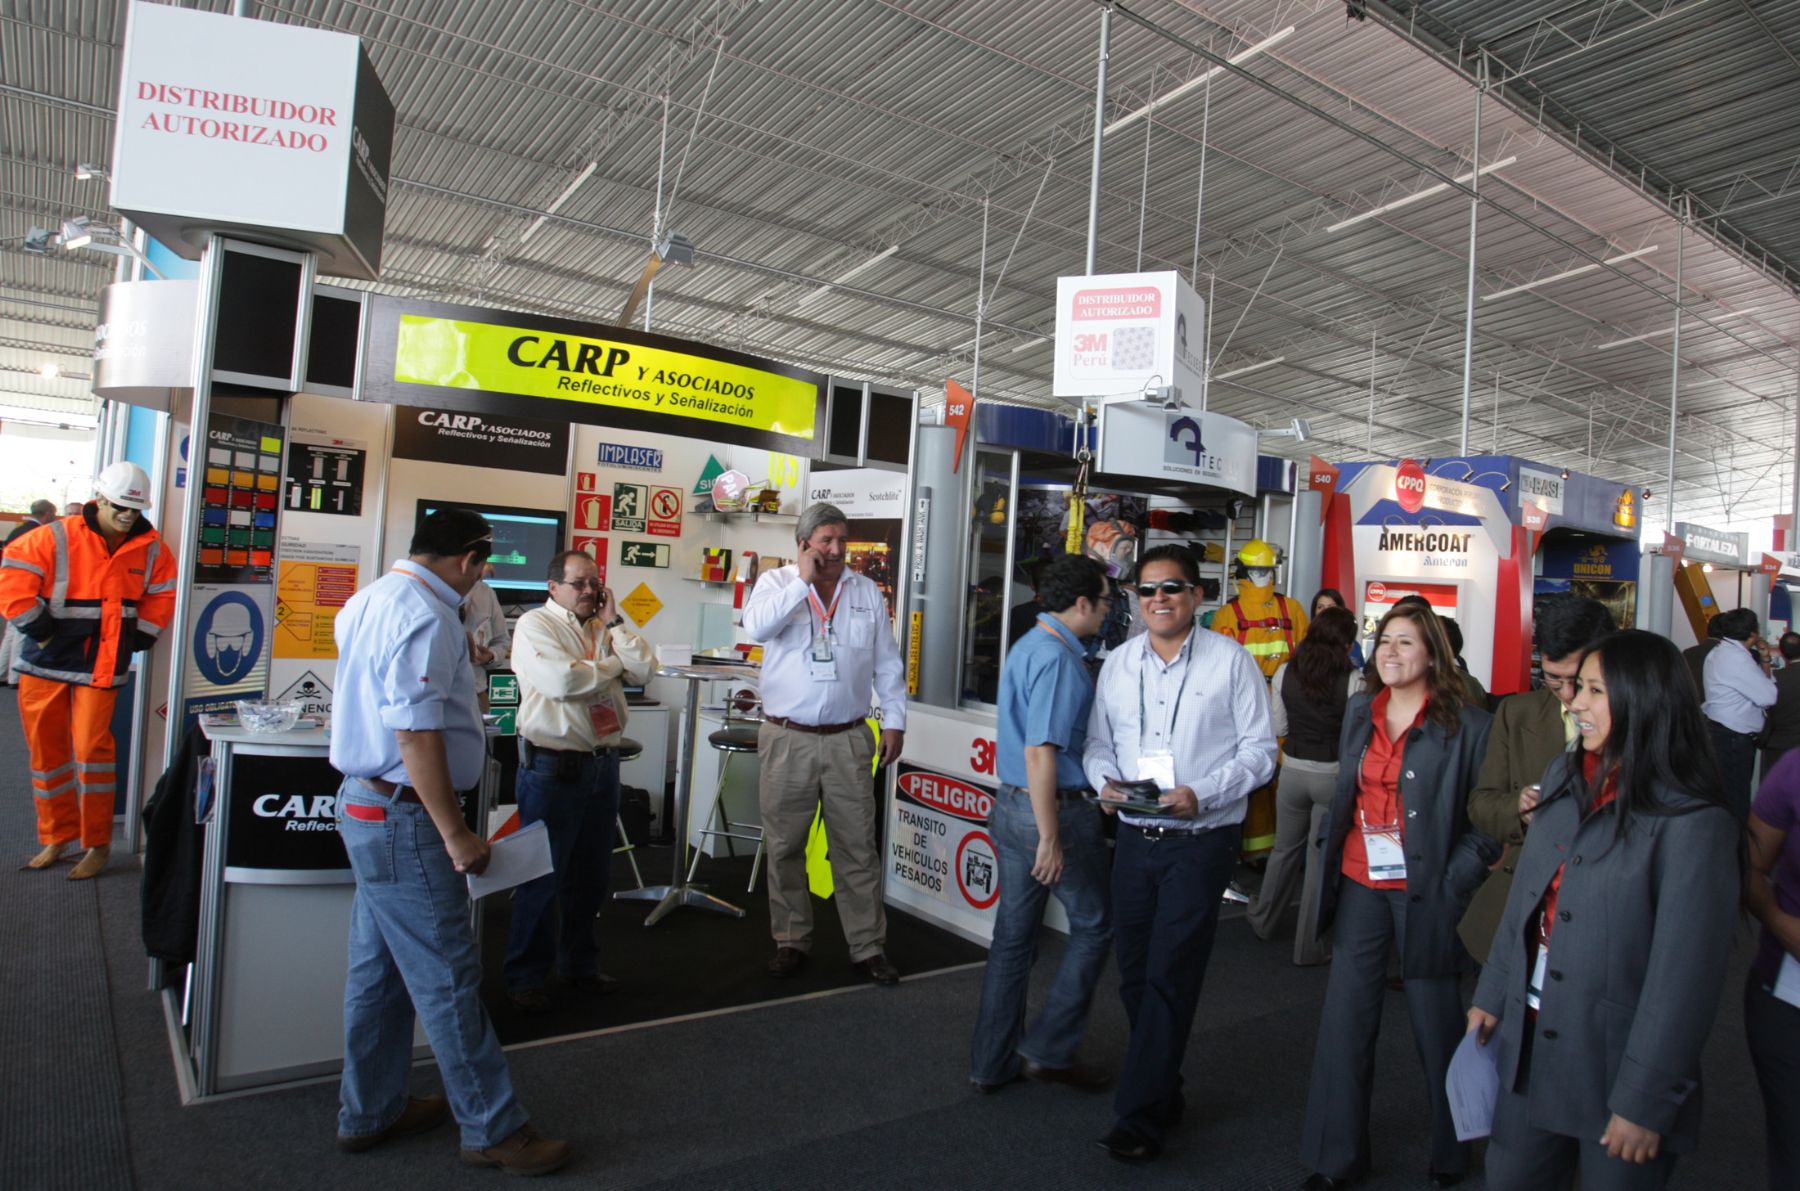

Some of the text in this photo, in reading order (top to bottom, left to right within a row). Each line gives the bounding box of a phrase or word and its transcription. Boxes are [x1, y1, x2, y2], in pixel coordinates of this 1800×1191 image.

[137, 81, 337, 127] DISTRIBUIDOR
[141, 112, 328, 153] AUTORIZADO
[1078, 292, 1156, 305] DISTRIBUIDOR
[1080, 305, 1153, 318] AUTORIZADO
[1073, 334, 1108, 353] 3M
[507, 335, 756, 401] CARP Y ASOCIADOS
[557, 376, 754, 419] Reflectivos y Señalización
[949, 404, 965, 416] 542
[209, 430, 232, 441] CARP
[417, 411, 552, 440] CARP Y ASOCIADOS
[438, 428, 488, 441] Reflectivos
[497, 435, 551, 448] Señalización
[600, 445, 661, 468] IMPLASER
[1314, 474, 1332, 484] 540
[1397, 475, 1424, 493] CPPQ
[811, 489, 831, 500] CARP
[614, 519, 643, 529] SALIDA
[1378, 532, 1472, 553] AMERCOAT
[1685, 533, 1740, 558] FORTALEZA
[1573, 563, 1612, 575] UNICON
[278, 606, 285, 616] 2
[910, 775, 991, 815] PELIGRO
[898, 808, 947, 837] TRANSITO
[913, 833, 927, 848] DE
[892, 842, 948, 876] VEHICULOS
[895, 864, 942, 892] PESADOS
